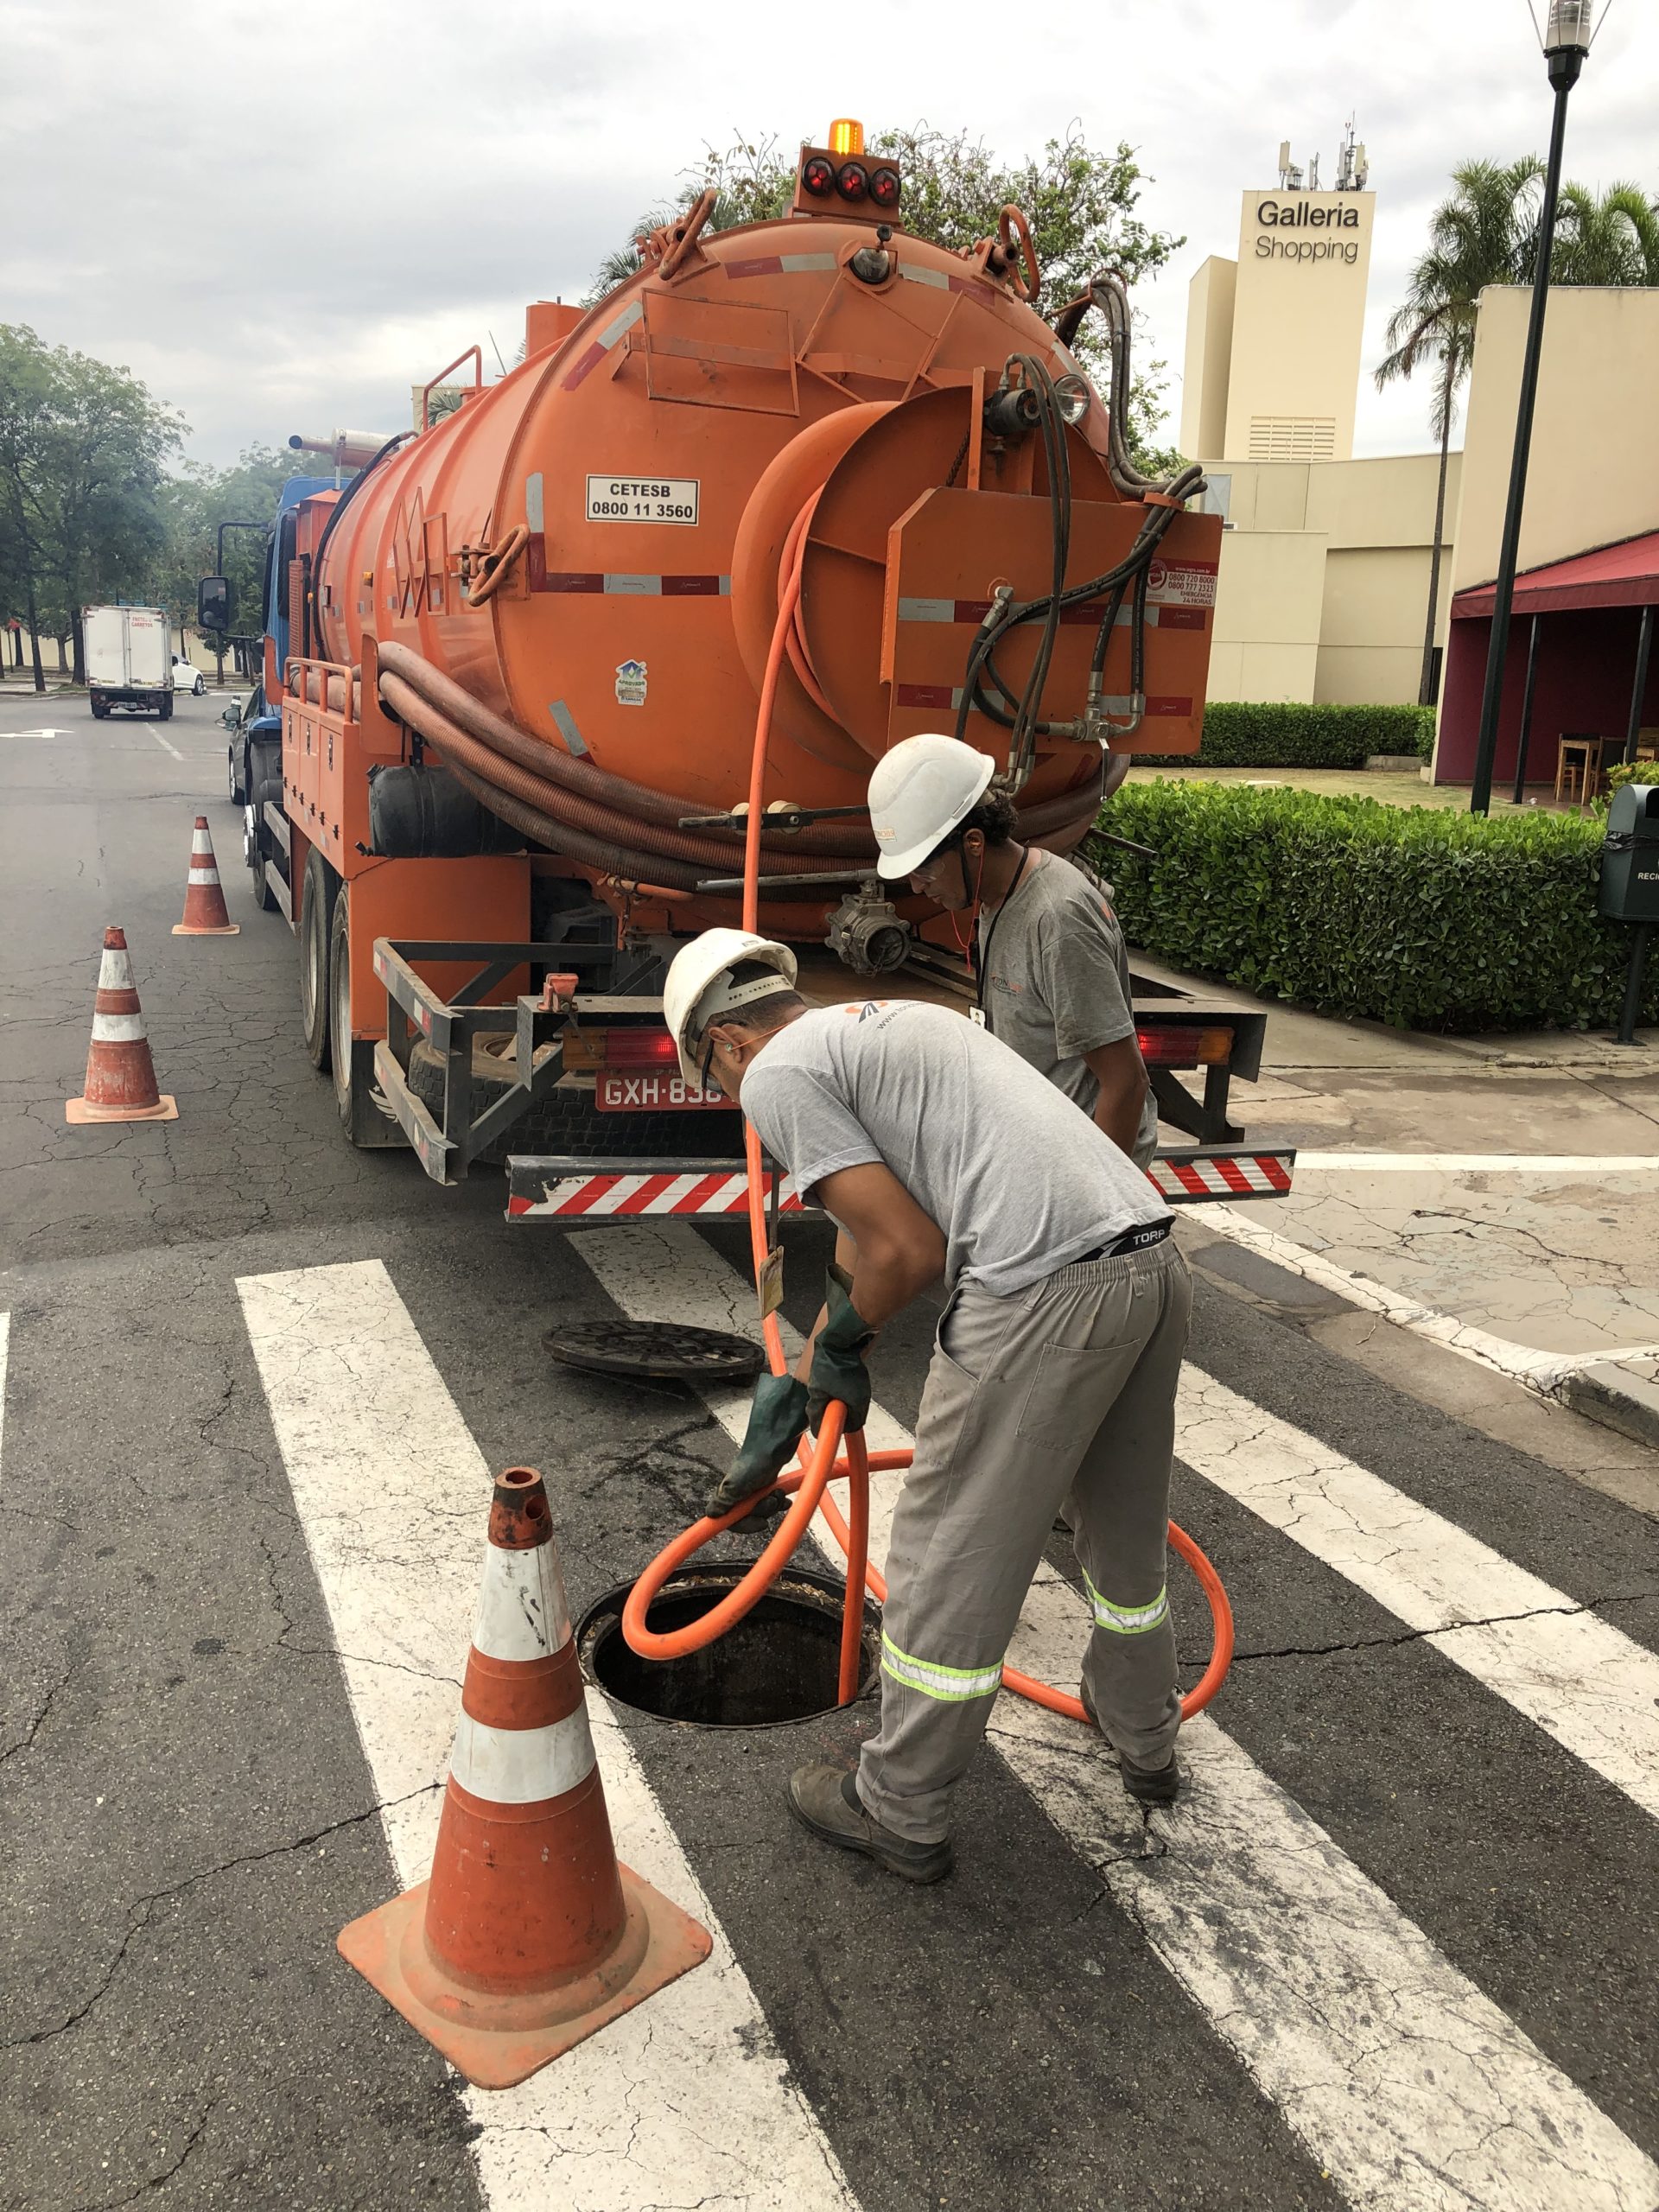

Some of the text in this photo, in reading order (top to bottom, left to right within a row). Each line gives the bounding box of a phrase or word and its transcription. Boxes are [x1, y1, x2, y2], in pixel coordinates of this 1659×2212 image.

[1257, 200, 1359, 227] Galleria
[1255, 235, 1359, 264] Shopping
[610, 483, 671, 498] CETESB
[592, 501, 693, 518] 0800 11 3560
[1168, 573, 1185, 582] 0800
[1637, 872, 1659, 880] RECI
